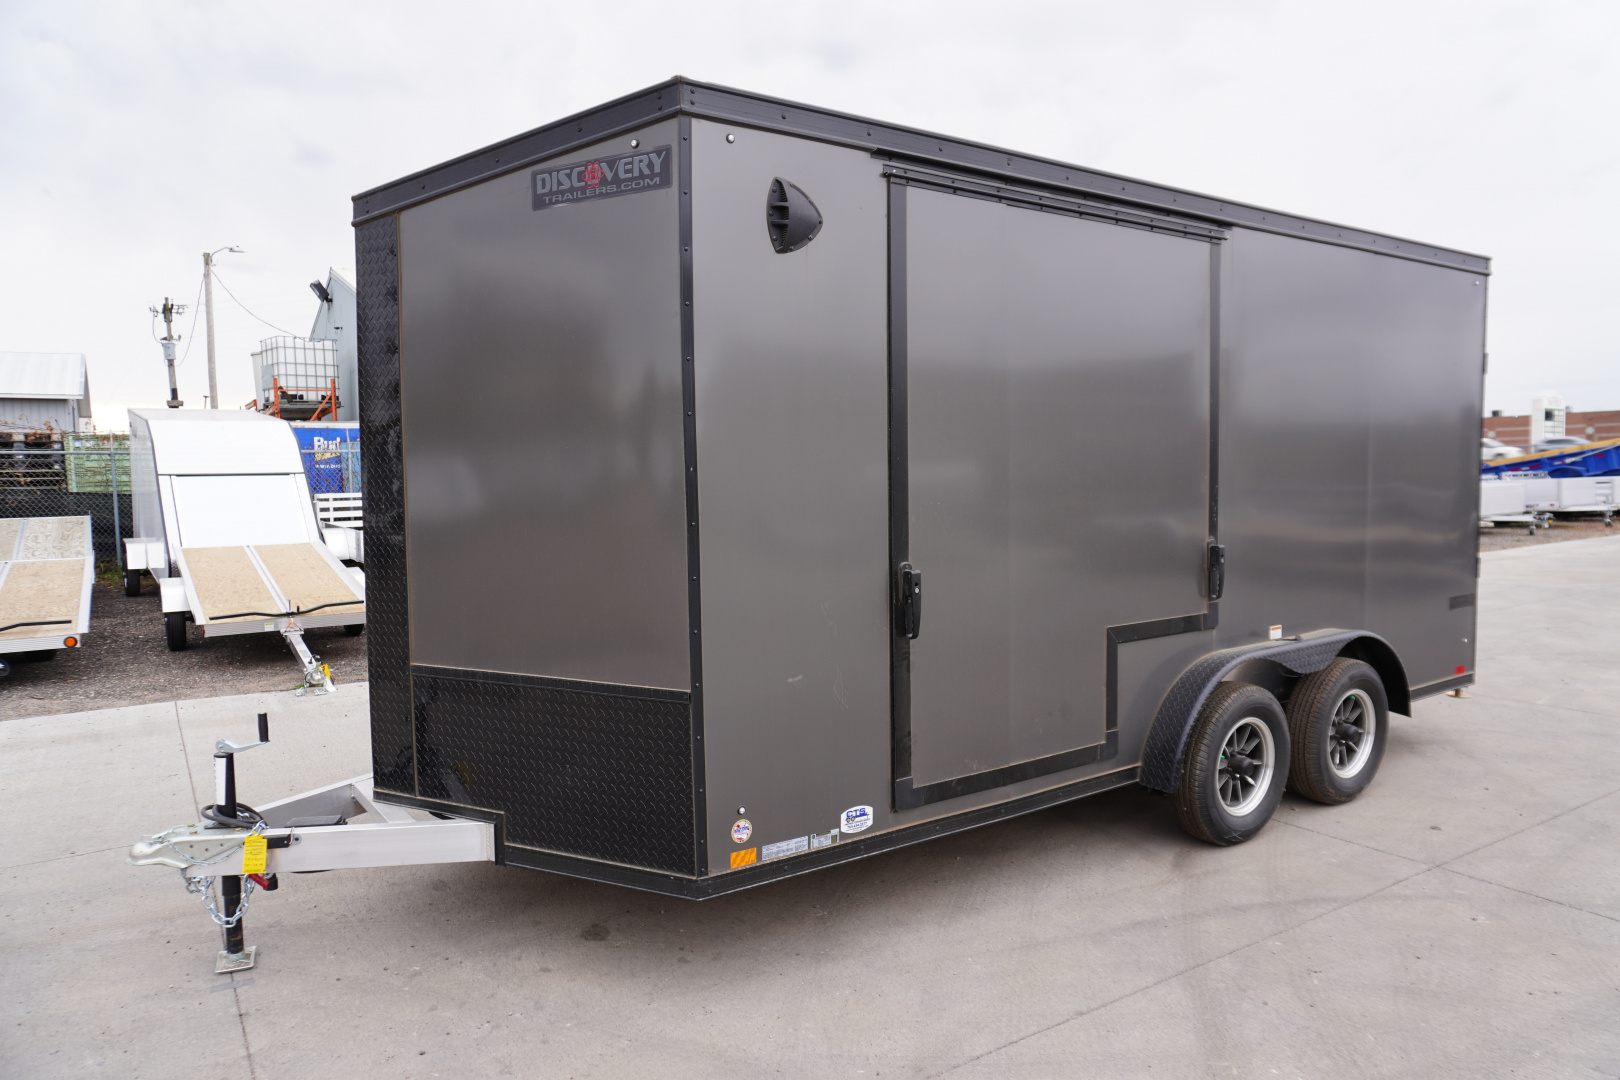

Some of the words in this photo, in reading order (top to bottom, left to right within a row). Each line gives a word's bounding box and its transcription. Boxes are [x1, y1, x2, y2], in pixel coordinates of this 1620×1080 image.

[536, 151, 666, 195] DISCOVERY
[543, 177, 660, 204] TRAILERS.COM
[846, 807, 868, 818] CTS
